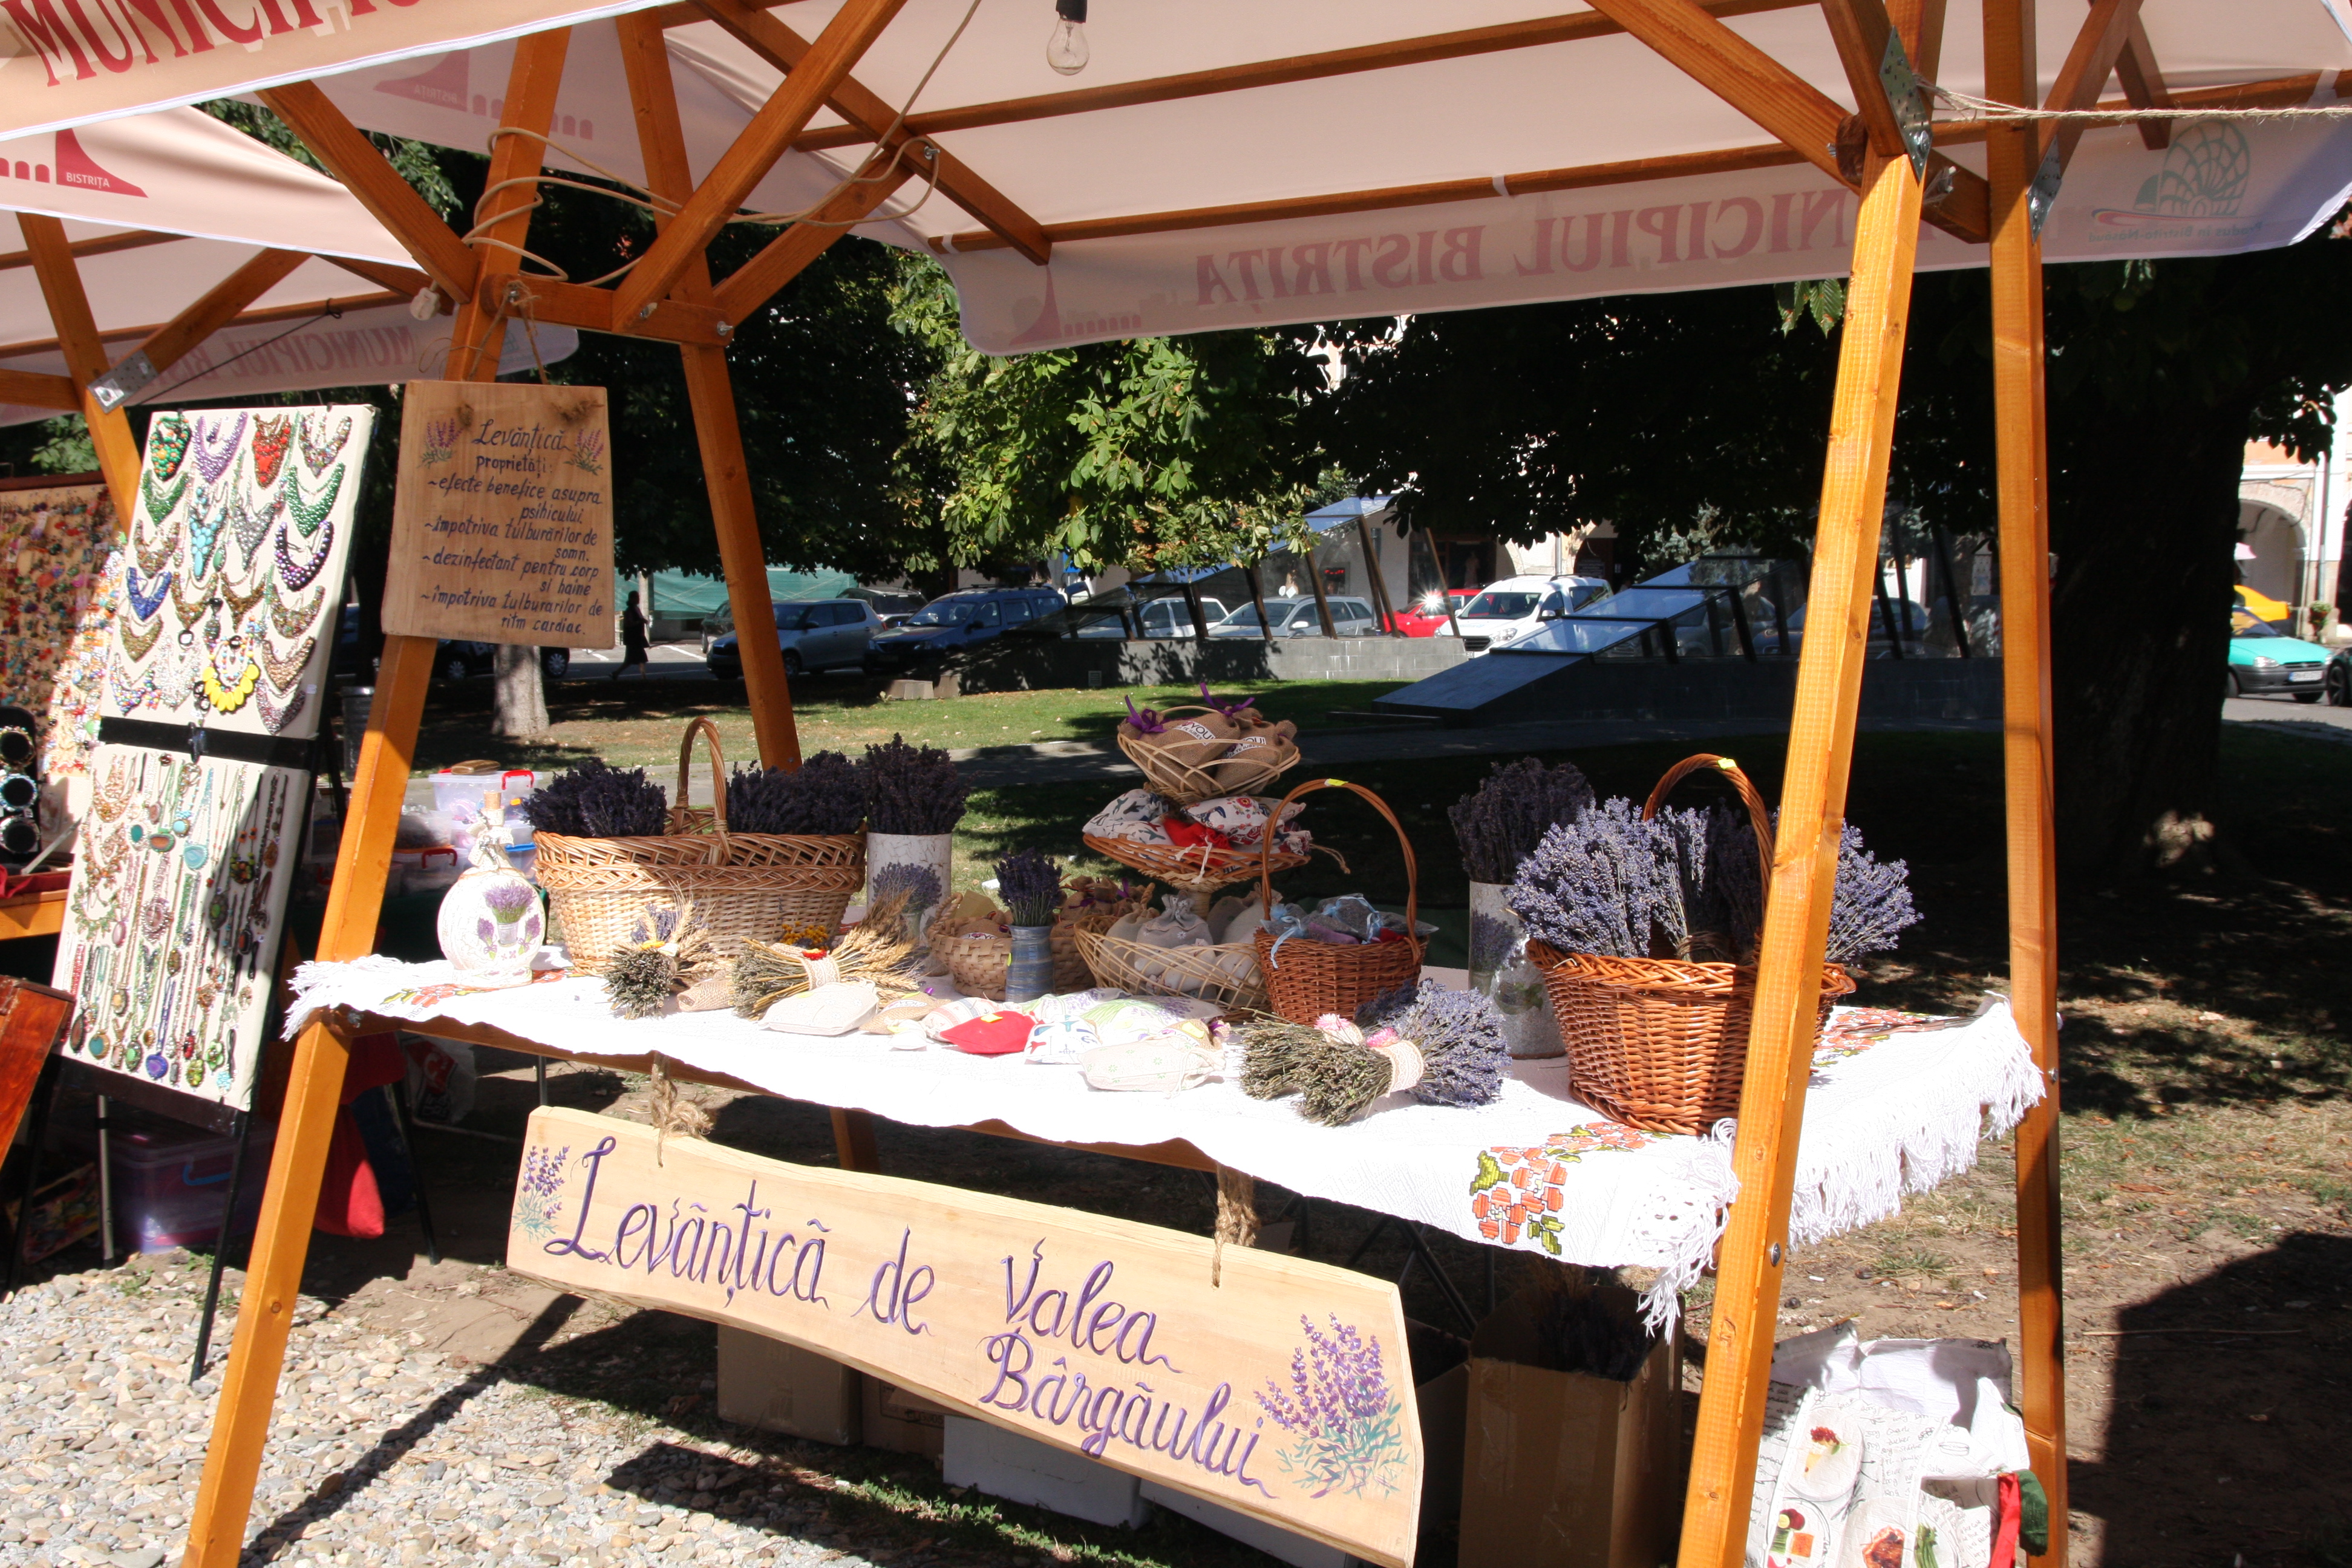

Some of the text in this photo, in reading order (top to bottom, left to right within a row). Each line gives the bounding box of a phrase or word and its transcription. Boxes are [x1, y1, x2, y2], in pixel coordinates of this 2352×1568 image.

[486, 475, 545, 506] benefice
[552, 488, 604, 508] asupra
[520, 502, 584, 524] psihicului.
[583, 527, 598, 546] de
[554, 547, 590, 561] somn.
[520, 558, 567, 582] pentru
[570, 566, 599, 582] corp
[558, 580, 591, 596] haine
[588, 599, 603, 617] de
[501, 613, 587, 635] ritm cardiac.
[851, 1223, 936, 1337] de
[1001, 1236, 1183, 1374] Valea
